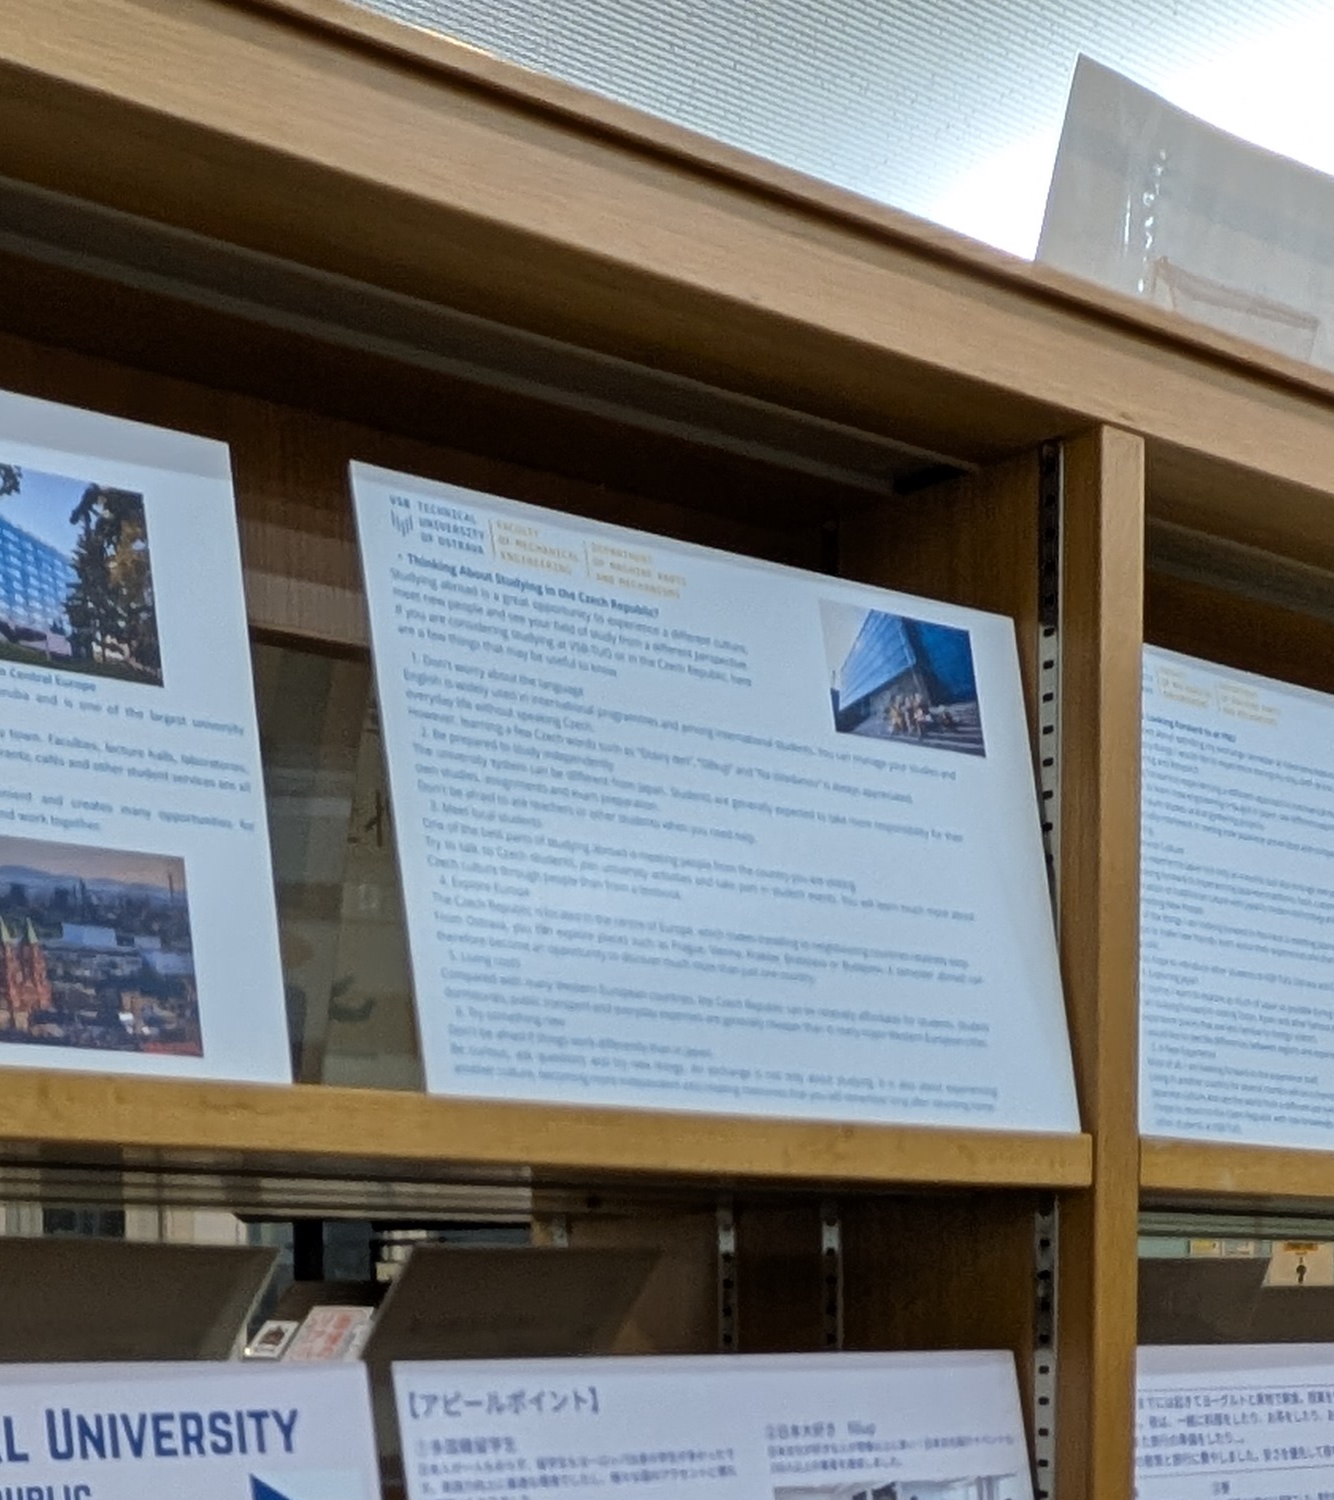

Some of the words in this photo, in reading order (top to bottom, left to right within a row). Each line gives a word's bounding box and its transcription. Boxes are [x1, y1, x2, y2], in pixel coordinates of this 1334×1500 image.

[388, 494, 411, 510] VSB
[416, 500, 477, 525] TECHNICAL
[417, 516, 486, 542] UNIVERSITY
[419, 531, 436, 546] OF
[436, 535, 485, 557] OSTRAVA
[406, 552, 459, 578] Thinking
[457, 563, 495, 583] About
[493, 571, 545, 597] Studying
[542, 582, 558, 597] in
[555, 584, 578, 601] the
[575, 589, 610, 608] Czech
[7, 665, 54, 685] Central
[52, 673, 97, 696] Europe
[407, 1385, 600, 1421] 【アピールポイント】
